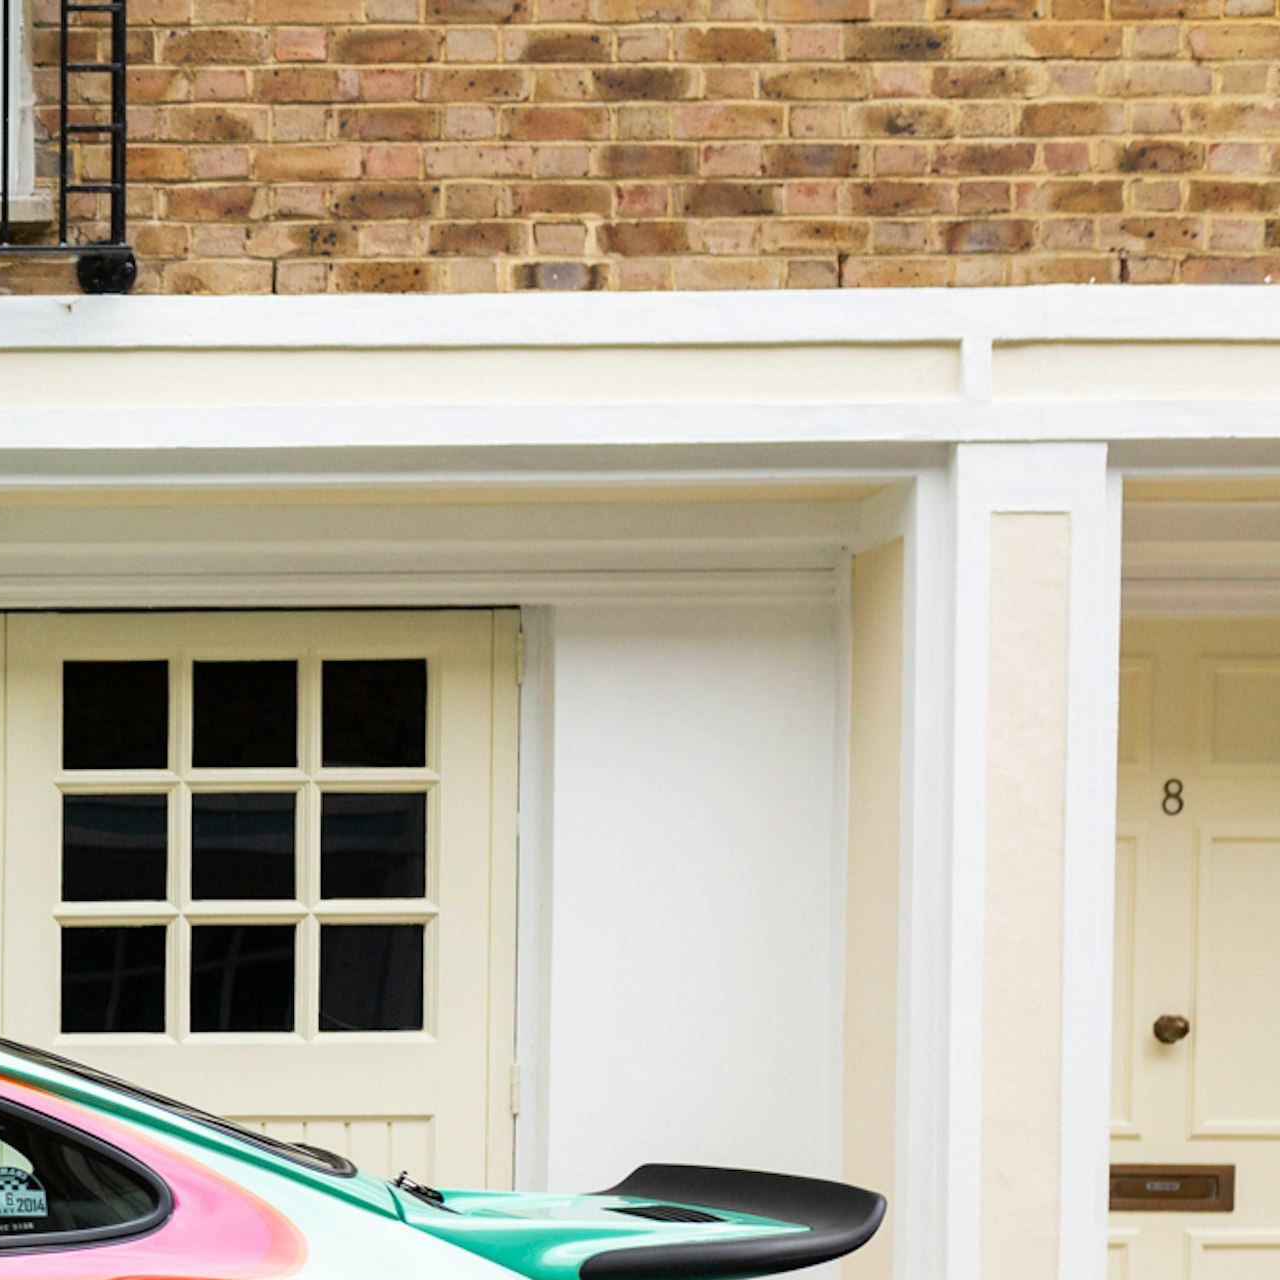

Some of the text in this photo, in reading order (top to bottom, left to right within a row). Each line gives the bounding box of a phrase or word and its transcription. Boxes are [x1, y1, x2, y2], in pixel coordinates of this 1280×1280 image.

[1162, 778, 1184, 816] 8
[6, 1192, 13, 1206] 6
[16, 1198, 45, 1213] 2014
